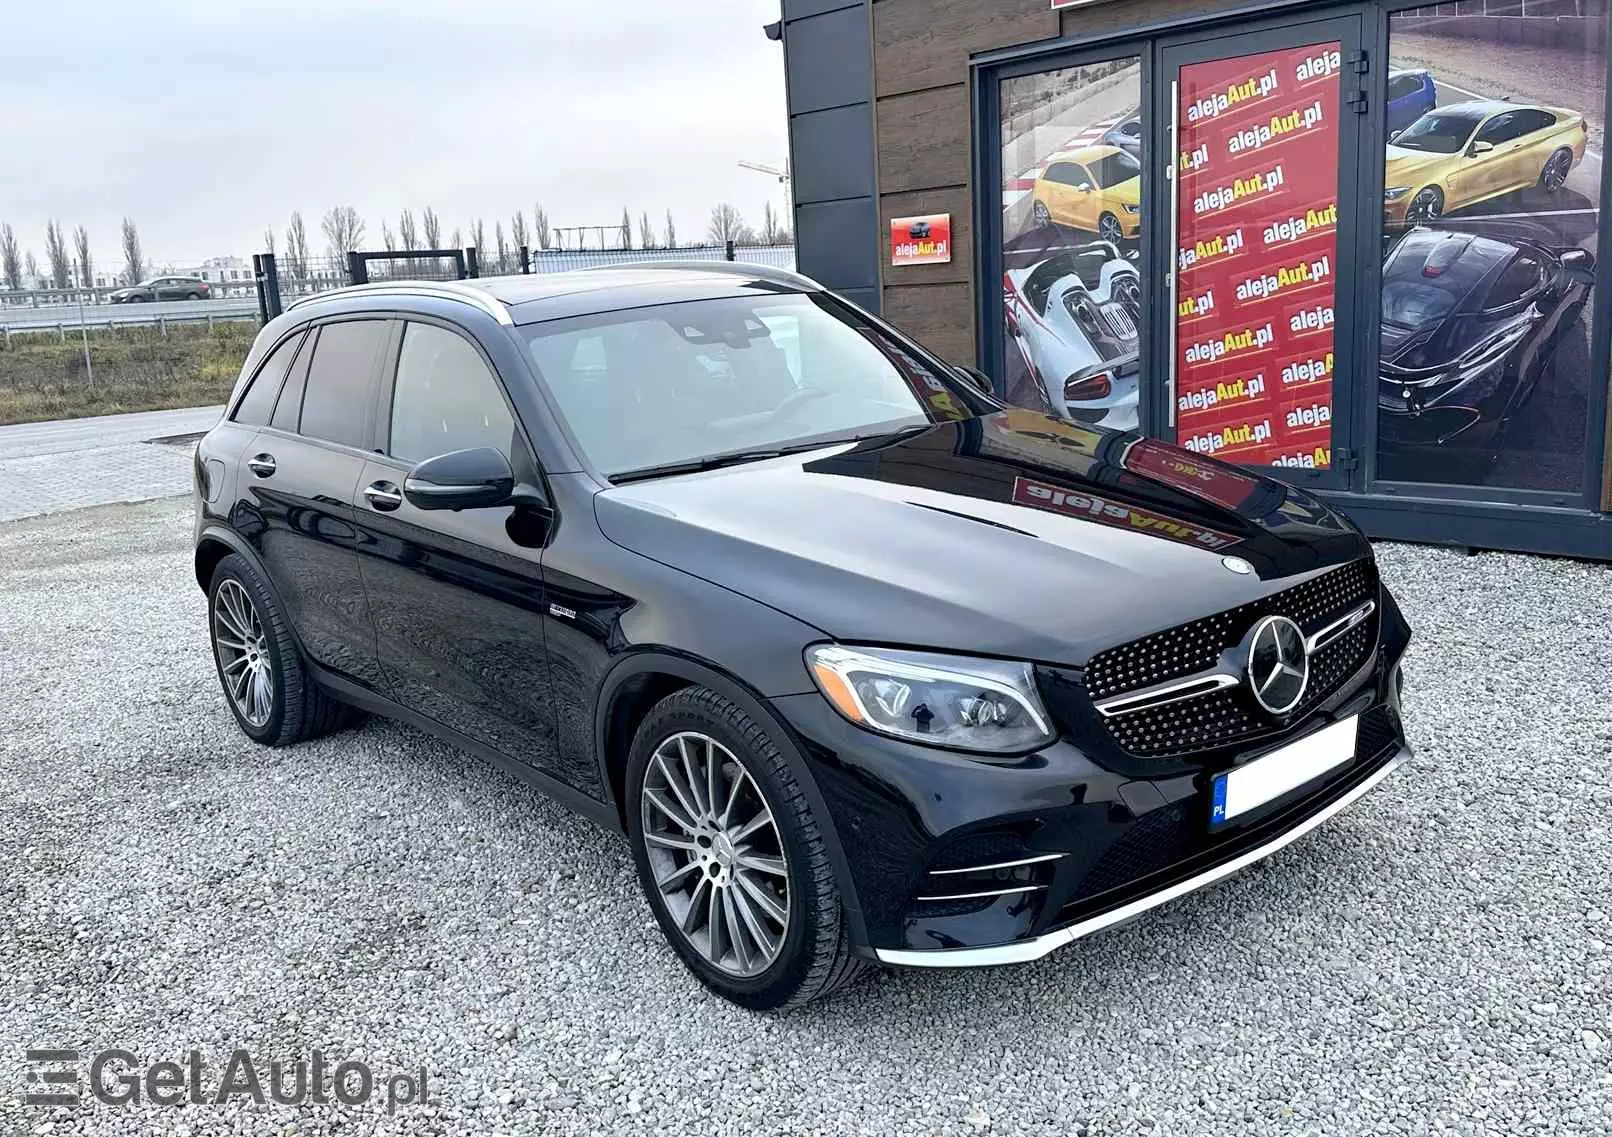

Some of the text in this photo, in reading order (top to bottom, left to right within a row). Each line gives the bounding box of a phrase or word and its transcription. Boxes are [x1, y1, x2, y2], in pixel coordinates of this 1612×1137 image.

[1296, 51, 1341, 81] aleja
[1187, 69, 1279, 122] alejaAut.pl
[1228, 101, 1323, 153] alejaAut.pl
[1180, 143, 1209, 171] t.pl
[1193, 165, 1284, 214] alejaAut.pl
[1263, 203, 1337, 244] alejaAut
[895, 239, 947, 258] alejaAut.pl
[1236, 256, 1330, 301] alejaAut.pl
[1290, 306, 1335, 332] aleja
[1185, 323, 1274, 363] alejaAut.pl
[1178, 374, 1265, 410] alejaAut.pl
[1286, 403, 1331, 428] aleja
[1185, 419, 1272, 454] alejaAut.pl
[1213, 804, 1225, 817] PL
